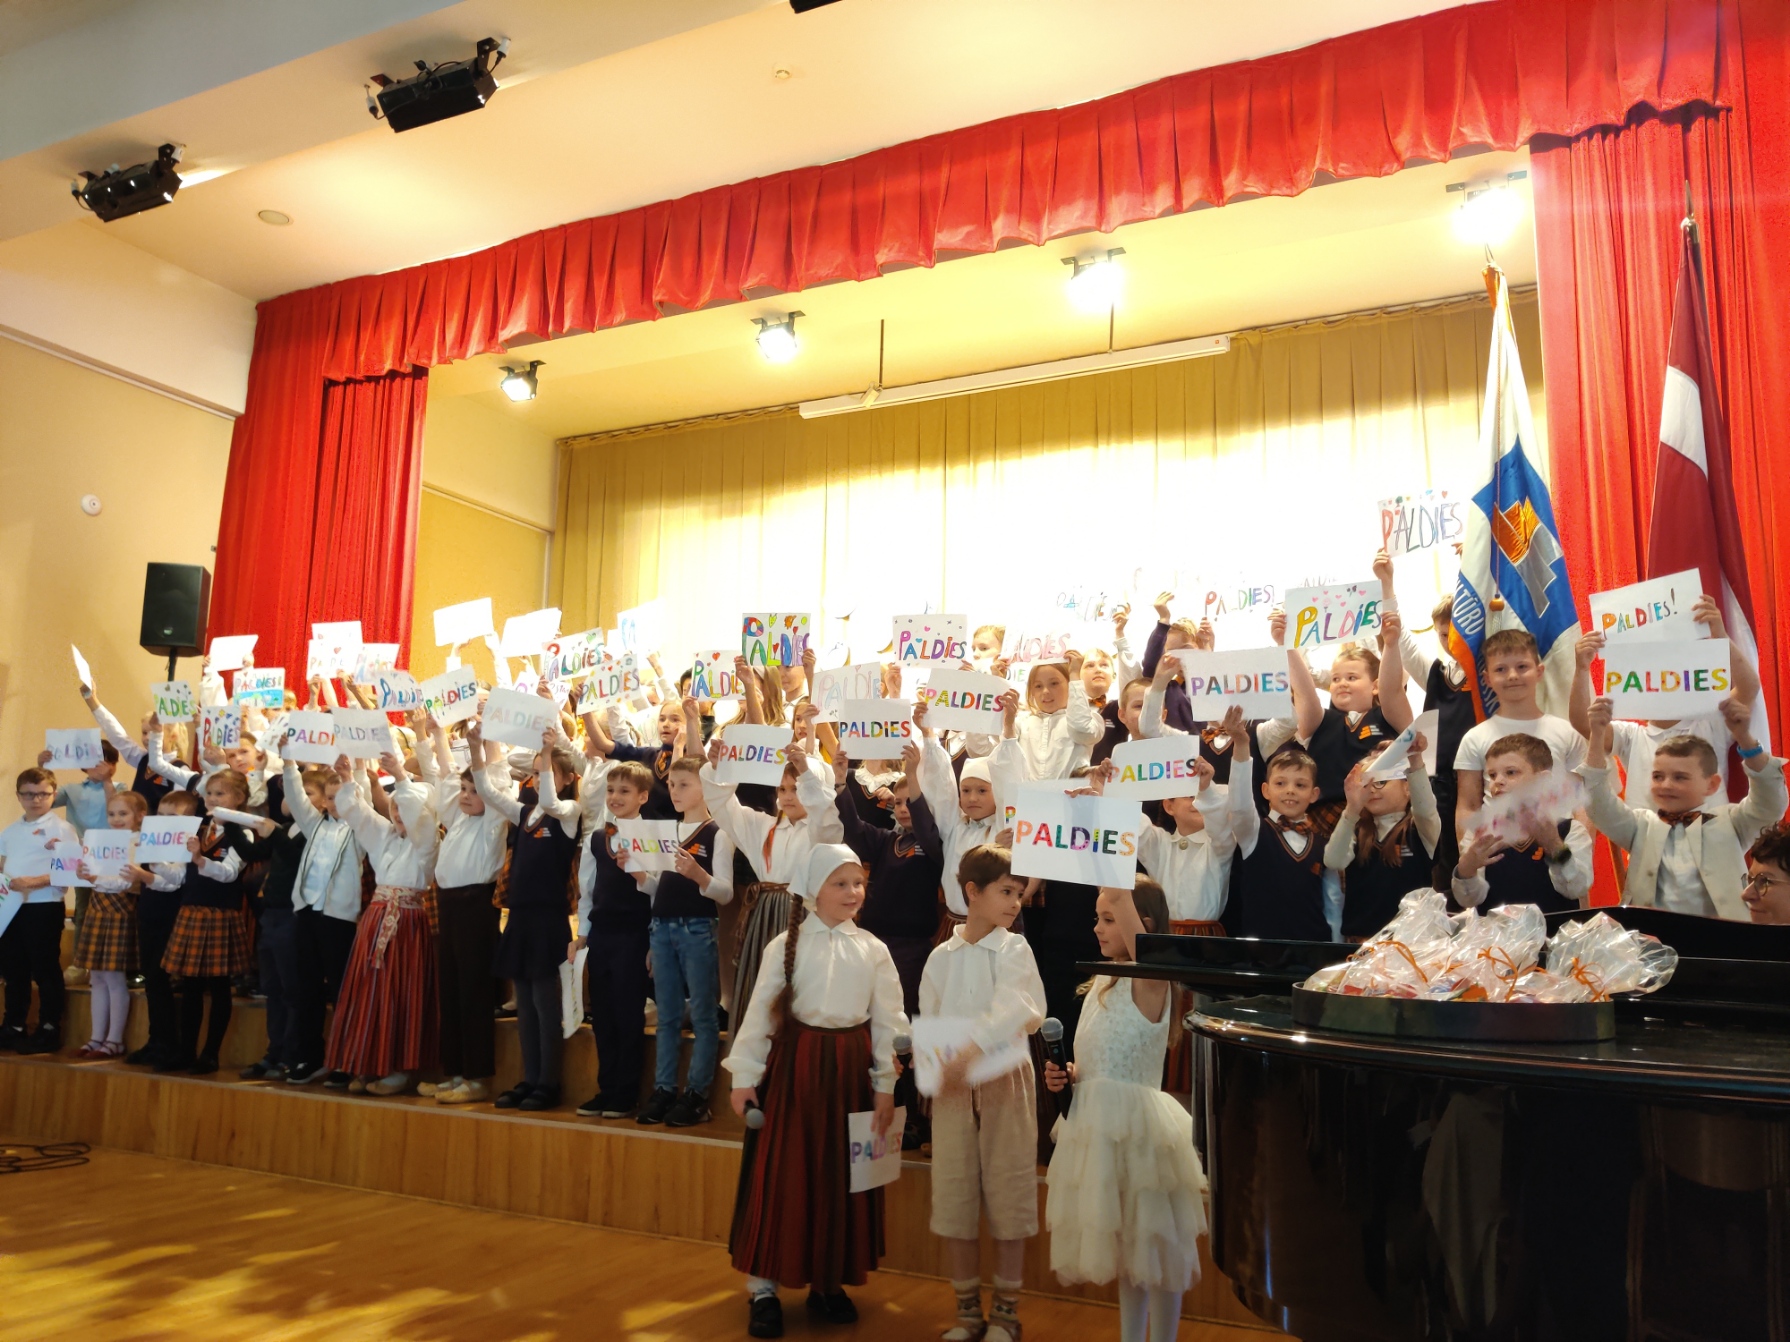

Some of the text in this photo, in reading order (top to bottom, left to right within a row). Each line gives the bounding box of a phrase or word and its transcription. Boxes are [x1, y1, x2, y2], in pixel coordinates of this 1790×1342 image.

[1381, 502, 1463, 552] PALDIES
[1294, 600, 1382, 649] PALDIES
[1602, 588, 1678, 640] PALDIES!
[899, 631, 967, 661] PALDIES
[545, 643, 604, 681] PALDIES
[579, 667, 640, 706] PALDIES
[1190, 672, 1289, 696] PALDIES
[1605, 667, 1728, 693] PALDIES
[924, 687, 1004, 713] PALDIES
[839, 720, 911, 738] PALDIES
[718, 744, 786, 766] PALDIES
[1107, 758, 1198, 783] PALDIES
[621, 838, 679, 854] PALDIES
[1016, 819, 1136, 857] PALDIES
[83, 845, 128, 860] PALDIES
